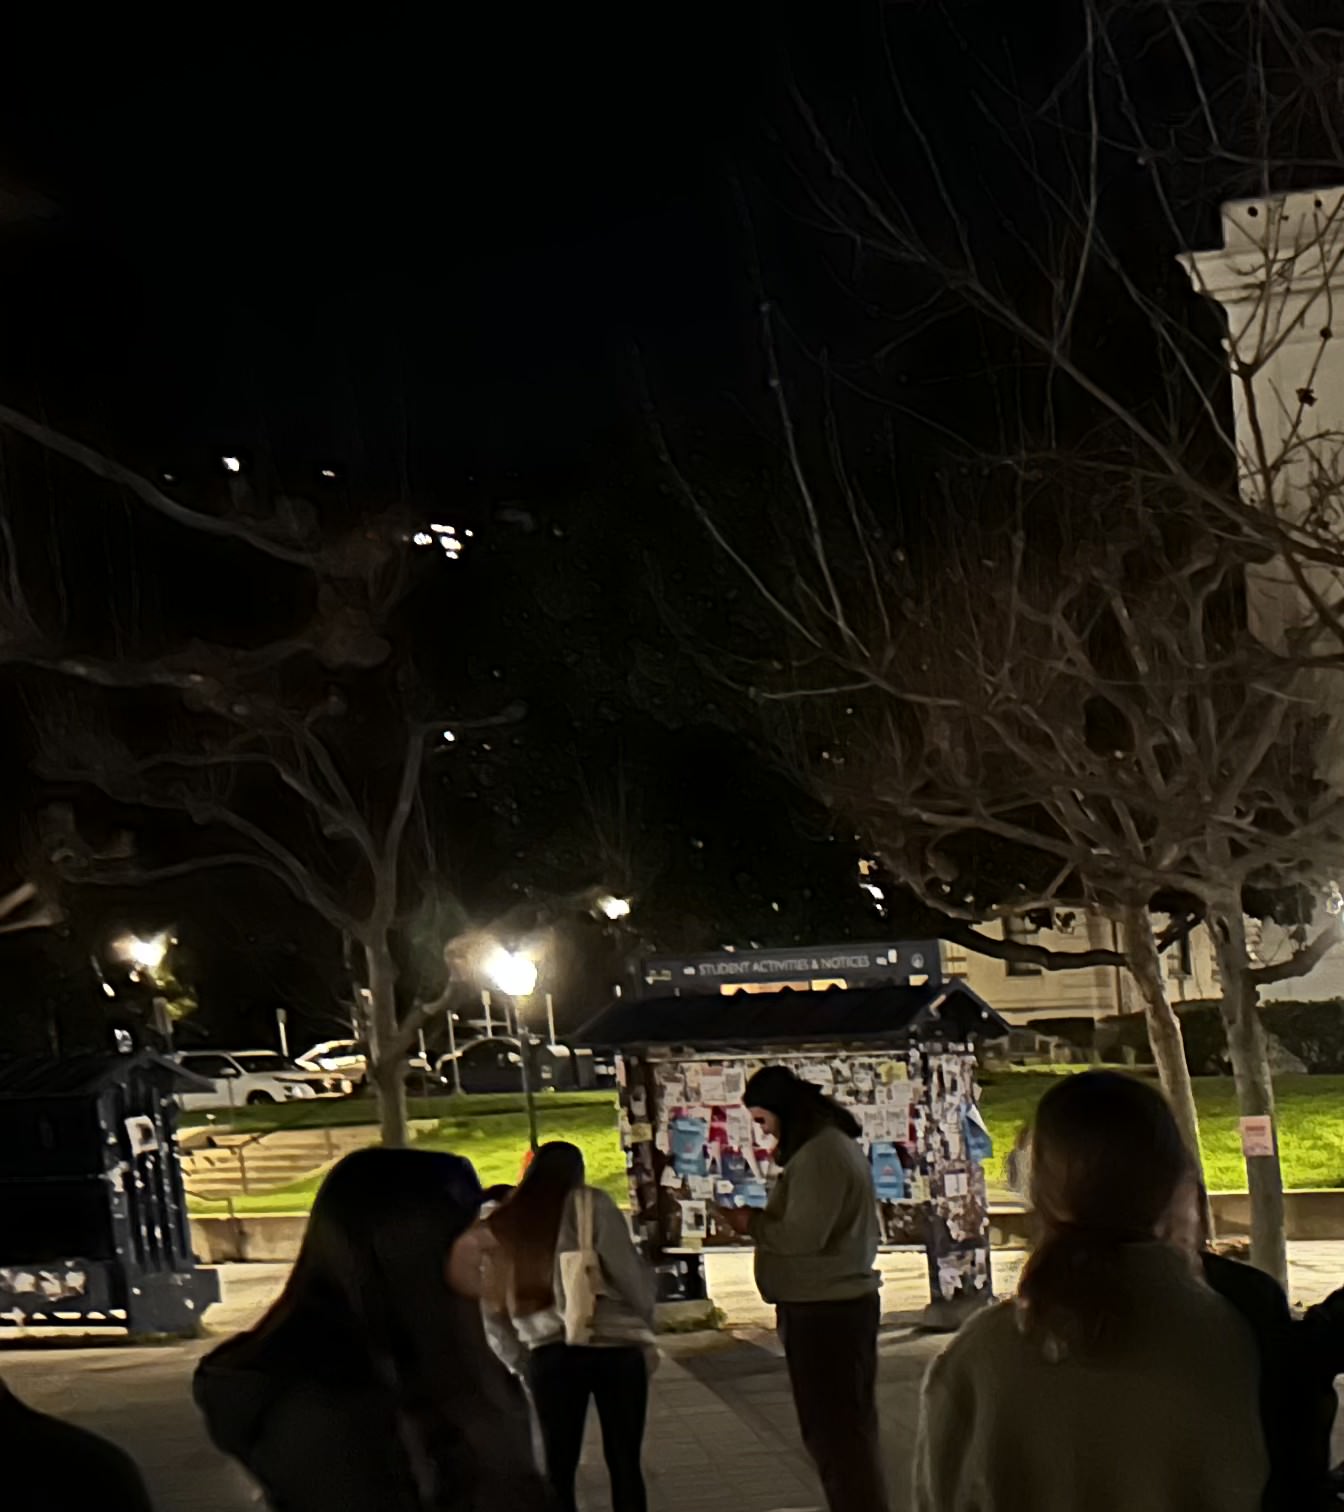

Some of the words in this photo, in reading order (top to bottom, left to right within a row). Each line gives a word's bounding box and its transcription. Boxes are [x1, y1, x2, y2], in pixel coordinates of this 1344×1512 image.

[698, 961, 750, 976] STUDENT
[753, 959, 809, 973] ACTIVITIES
[811, 959, 819, 970] &
[820, 955, 870, 970] NOTICES
